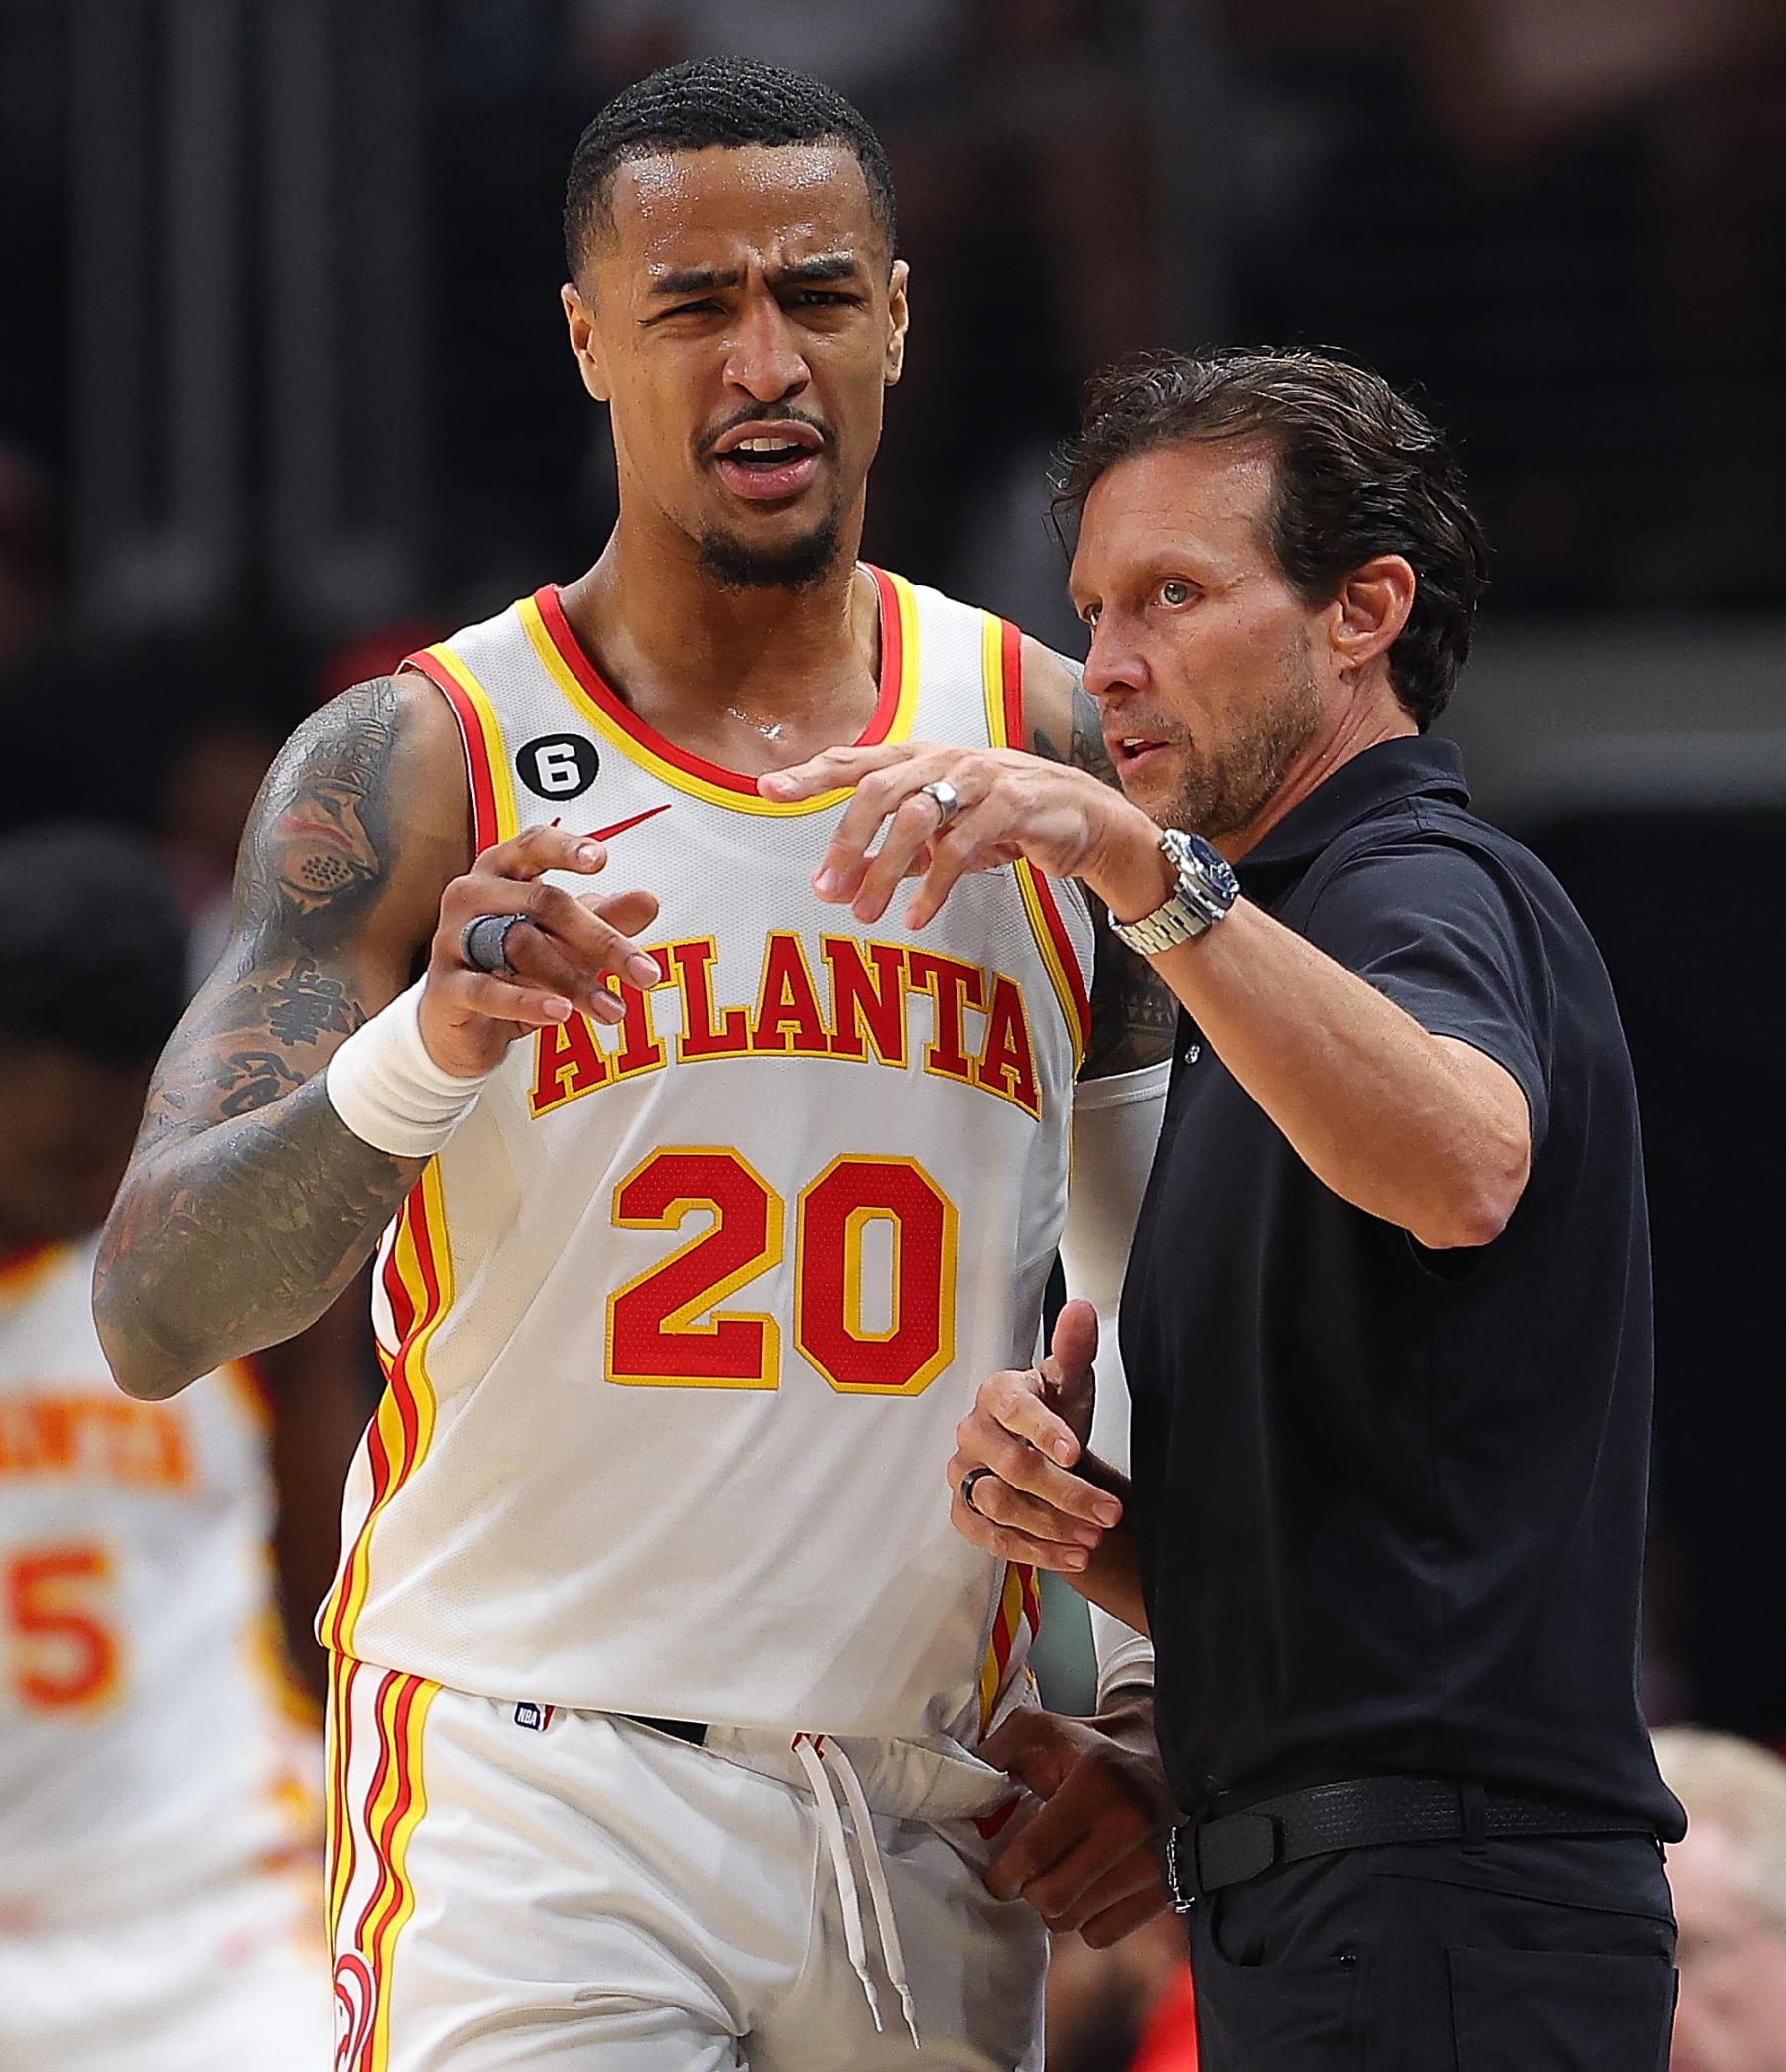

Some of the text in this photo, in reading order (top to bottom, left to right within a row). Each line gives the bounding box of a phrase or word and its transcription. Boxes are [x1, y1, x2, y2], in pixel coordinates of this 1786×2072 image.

[534, 742, 582, 793] 6
[528, 929, 1042, 1122] ATLANTA
[604, 1144, 959, 1396] 20
[8, 1541, 121, 1714] 5
[516, 1706, 538, 1727] NBA
